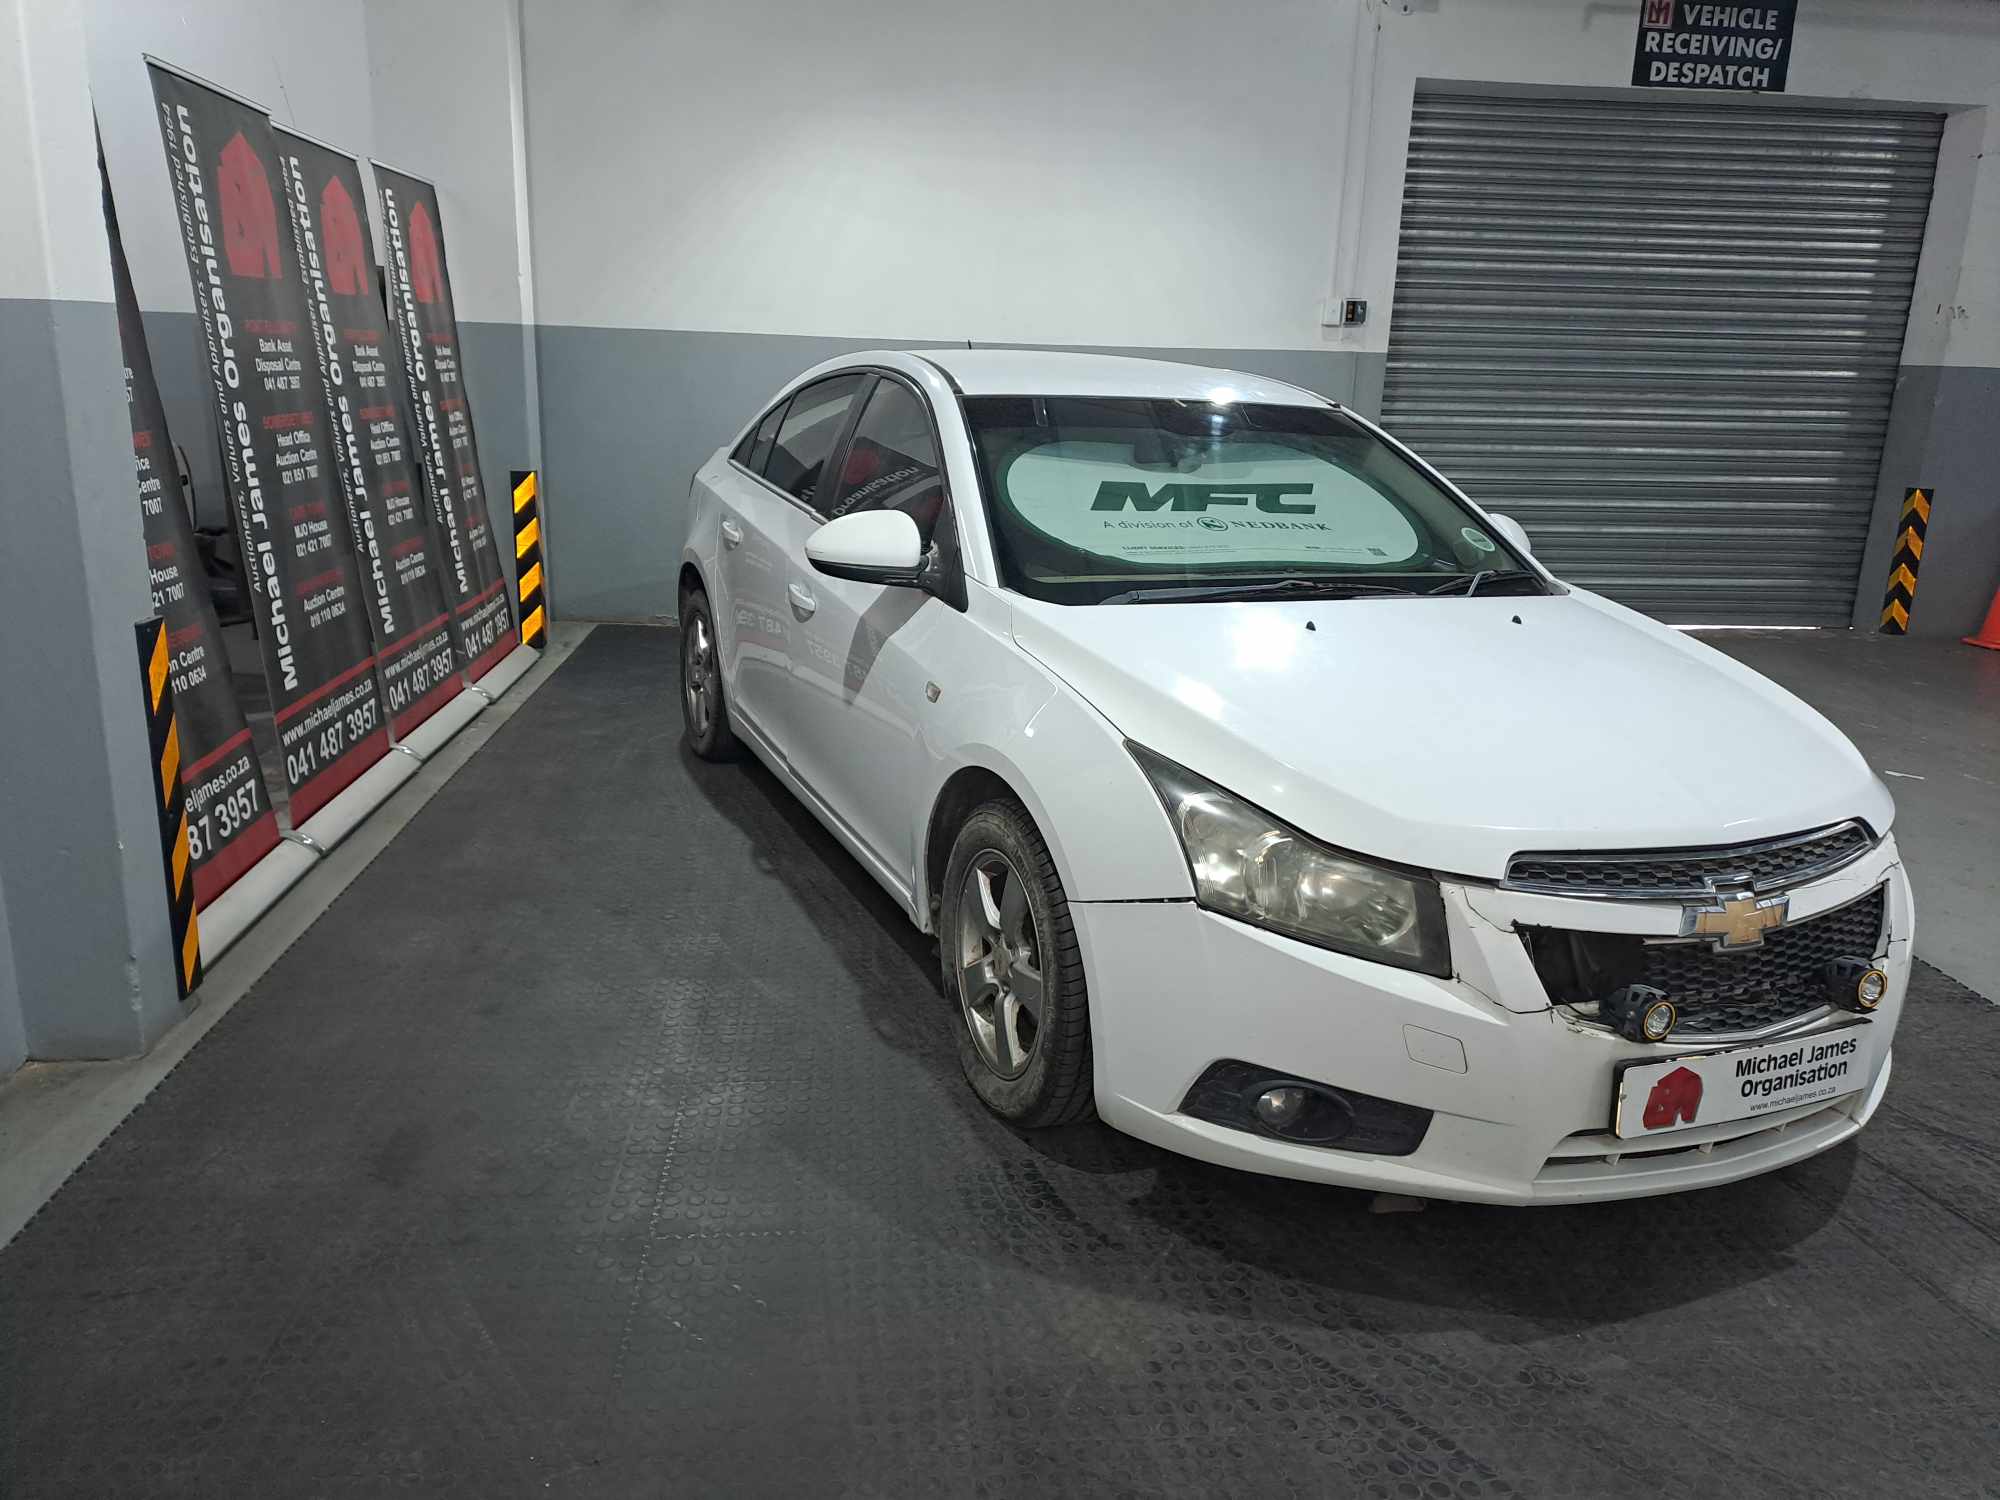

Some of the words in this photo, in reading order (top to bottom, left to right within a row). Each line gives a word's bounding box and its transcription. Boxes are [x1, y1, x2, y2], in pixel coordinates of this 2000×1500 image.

[1645, 31, 1783, 60] RECEIVING/
[1683, 4, 1779, 31] VEHICLE
[1650, 61, 1770, 87] DESPATCH
[170, 154, 199, 263] Established
[177, 104, 240, 389] Organisation
[289, 156, 343, 386] Organisation
[385, 188, 426, 382] Organisation
[198, 281, 221, 377] Appraisers
[214, 380, 228, 414] and
[224, 419, 240, 482] Valuers
[233, 401, 268, 530] James
[338, 396, 368, 501] James
[422, 390, 446, 480] James
[140, 478, 161, 495] entre
[142, 497, 163, 516] 7007
[1090, 480, 1317, 514] MFC
[440, 488, 468, 593] Michael
[1104, 520, 1116, 529] A
[1119, 520, 1177, 529] division
[1179, 519, 1194, 529] of
[1230, 520, 1332, 531] NEDBANK
[149, 566, 179, 585] House
[166, 582, 184, 603] 7007
[360, 510, 394, 634] Michael
[257, 541, 298, 691] Michael
[465, 631, 482, 659] 041
[179, 646, 205, 667] Centre
[389, 678, 411, 711] 041
[412, 663, 431, 695] 487
[430, 647, 453, 682] 3957
[282, 678, 373, 747] www.michaeljames.co.za
[287, 741, 316, 785] 041
[320, 721, 343, 760] 487
[346, 697, 377, 741] 3957
[215, 778, 259, 838] 3957
[1735, 1047, 1804, 1077] Michael
[1806, 1038, 1857, 1064] James
[1740, 1060, 1848, 1098] Organisation
